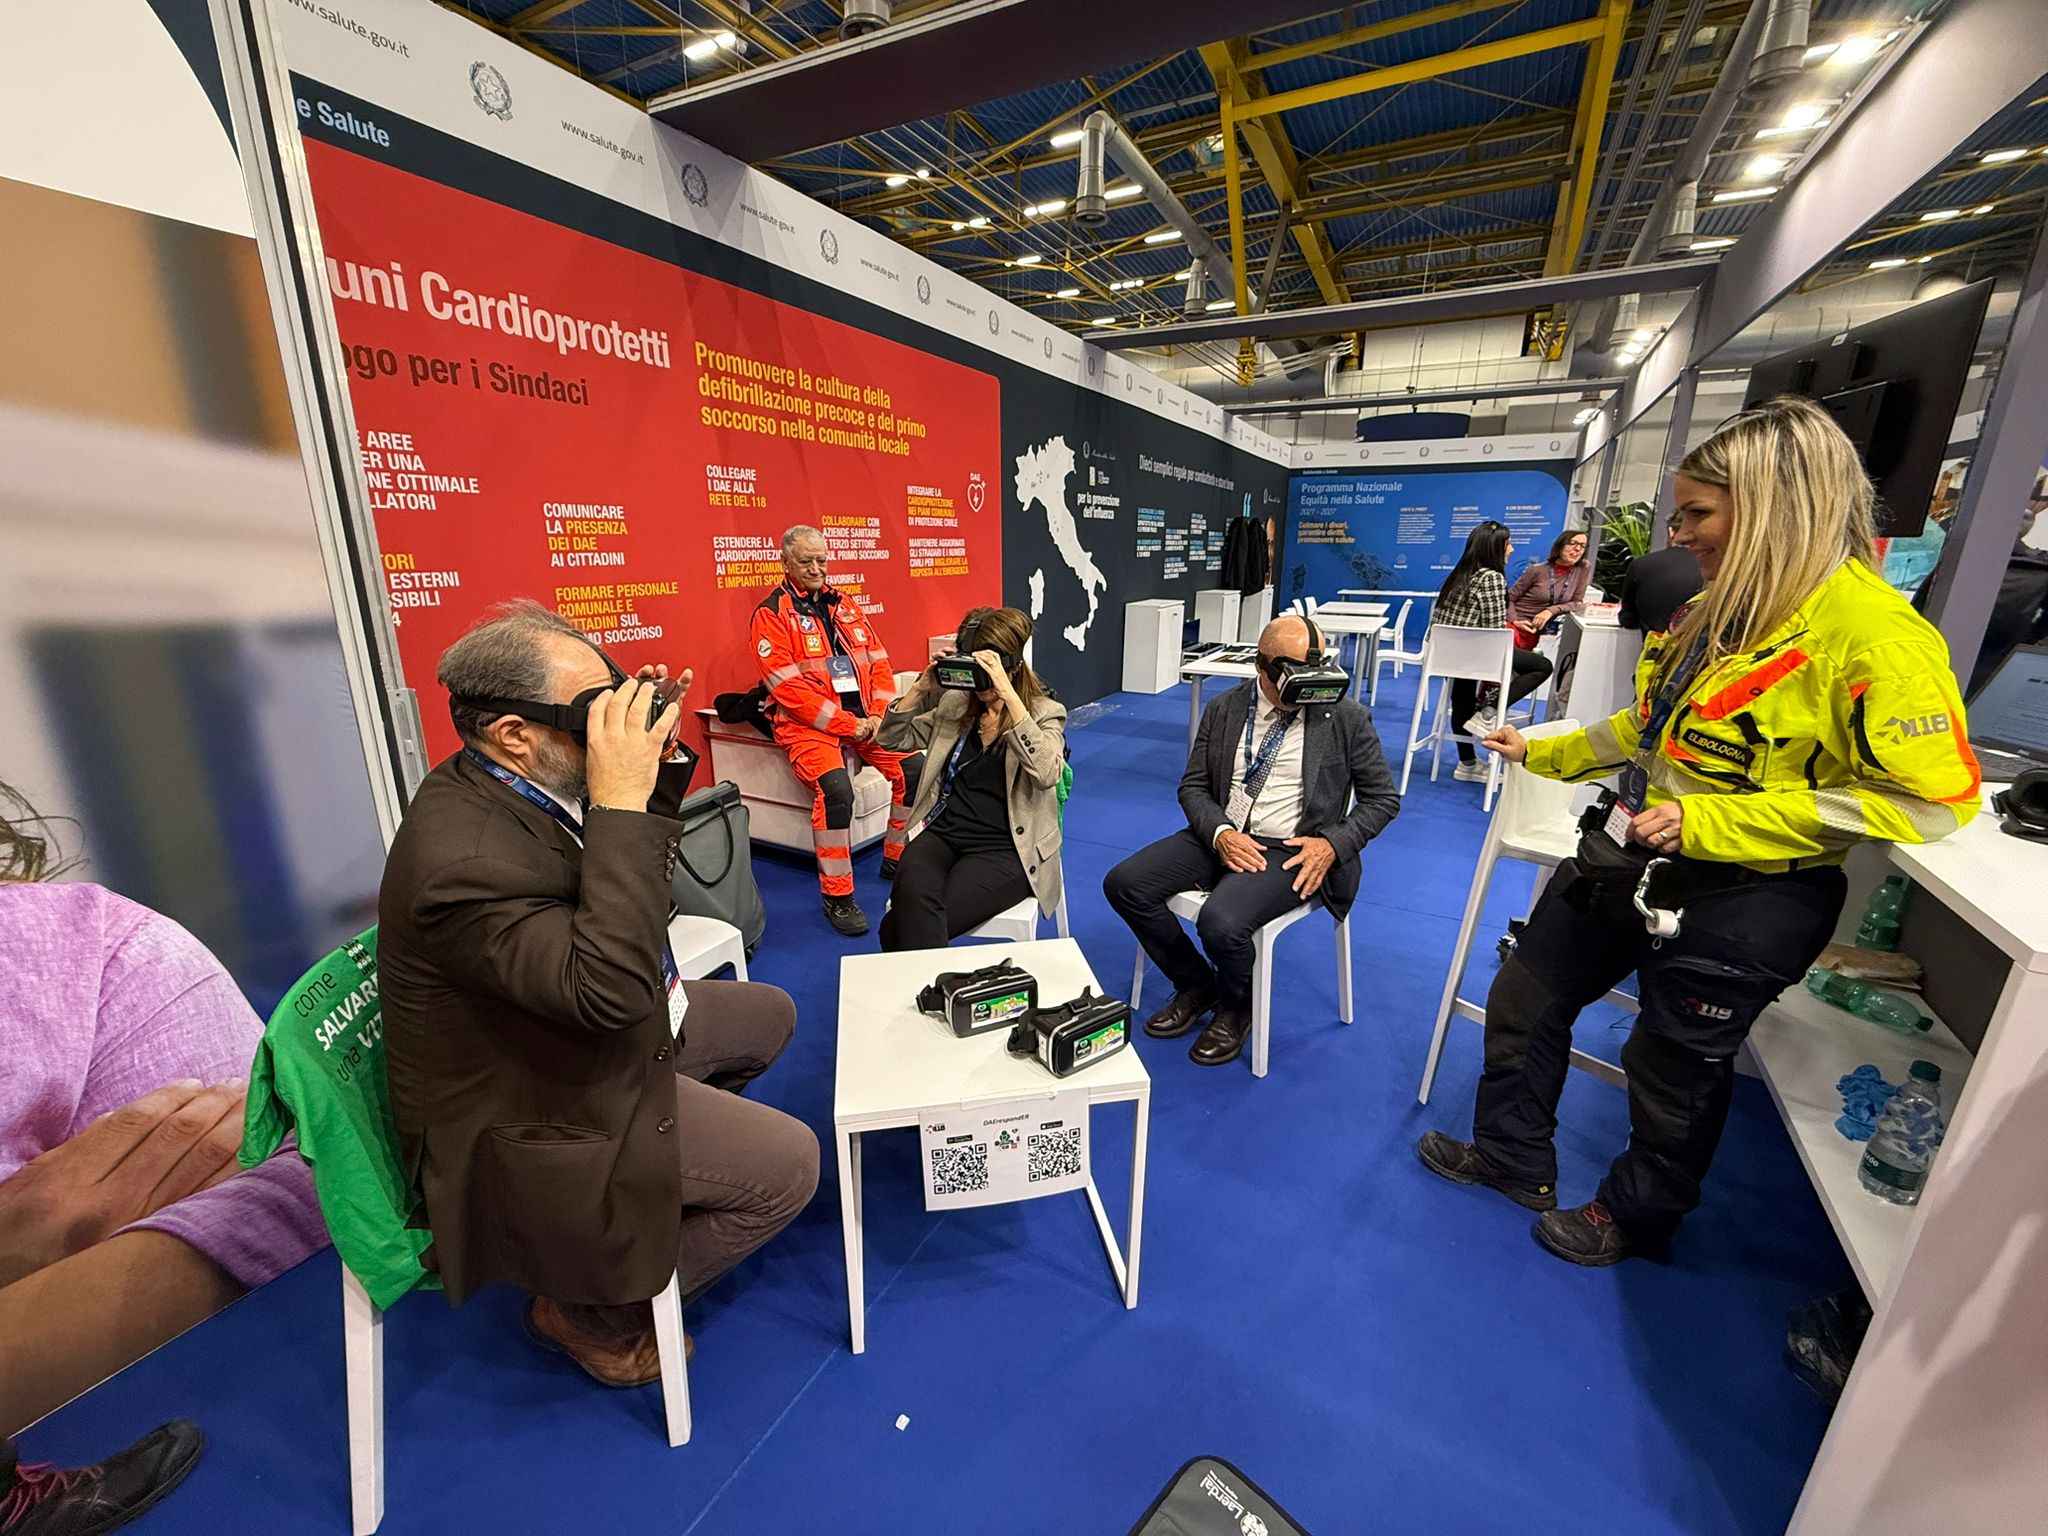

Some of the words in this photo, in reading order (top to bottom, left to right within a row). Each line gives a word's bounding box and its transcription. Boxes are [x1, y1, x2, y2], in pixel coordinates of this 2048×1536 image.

[296, 98, 312, 118] e
[317, 101, 390, 147] Salute
[561, 119, 645, 166] www.salute.gov.it
[739, 202, 795, 235] www.salute.gov.it
[420, 270, 671, 369] Cardioprotetti
[408, 353, 461, 387] per
[470, 358, 481, 389] i
[488, 360, 590, 406] Sindaci
[694, 341, 796, 388] Promuovere
[799, 367, 812, 391] la
[815, 376, 861, 402] cultura
[864, 385, 891, 410] della
[698, 372, 812, 416] defibrillazione
[815, 401, 865, 427] precoce
[868, 412, 875, 428] e
[877, 413, 894, 432] del
[897, 417, 926, 438] primo
[701, 405, 777, 436] soccorso
[781, 418, 815, 441] nella
[818, 426, 876, 451] comunità
[878, 433, 910, 456] locale
[366, 431, 414, 452] AREE
[387, 453, 426, 472] UNA
[706, 465, 757, 481] COLLEGARE
[364, 472, 394, 489] NE
[396, 473, 480, 494] OTTIMALE
[708, 480, 711, 491] I
[713, 480, 731, 493] DAE
[733, 481, 754, 494] ALLA
[1301, 483, 1354, 495] Programma
[1356, 481, 1403, 492] Nazionale
[709, 493, 732, 507] RETE
[734, 495, 750, 507] DEL
[751, 497, 766, 508] 118
[935, 488, 942, 497] LA
[1300, 494, 1328, 506] Equità
[1330, 494, 1352, 505] nella
[1354, 494, 1384, 505] Salute
[543, 503, 625, 519] COMUNICARE
[545, 520, 564, 534] LA
[565, 520, 628, 535] PRESENZA
[822, 515, 867, 527] COLLABORARE
[867, 516, 880, 527] CON
[823, 527, 850, 538] AZIENDE
[850, 528, 881, 538] SANITARIE
[548, 537, 570, 551] DEI
[573, 537, 598, 551] DAE
[713, 537, 762, 549] ESTENDERE
[763, 537, 774, 549] LA
[829, 539, 849, 549] TERZO
[850, 539, 876, 549] SETTORE
[380, 554, 415, 569] ORI
[551, 553, 564, 567] AI
[567, 552, 625, 567] CITTADINI
[838, 550, 858, 560] PRIMO
[859, 549, 889, 560] SOCCORSO
[716, 564, 725, 575] AI
[727, 563, 753, 575] MEZZI
[389, 571, 460, 589] ESTERNI
[717, 577, 723, 588] E
[725, 575, 762, 588] IMPIANTI
[826, 573, 855, 585] FAVORIRE
[856, 573, 865, 583] LA
[555, 585, 615, 601] FORMARE
[617, 582, 679, 598] PERSONALE
[557, 600, 624, 617] COMUNALE
[626, 599, 634, 612] E
[620, 613, 641, 627] SUL
[605, 625, 663, 643] SOCCORSO
[1907, 712, 1950, 738] 118
[1688, 732, 1746, 762] ELIBOLOGNA
[294, 972, 338, 1018] come
[337, 1045, 363, 1082] una
[982, 1113, 1030, 1126] DAErespondER
[1200, 1476, 1244, 1519] Laerdal
